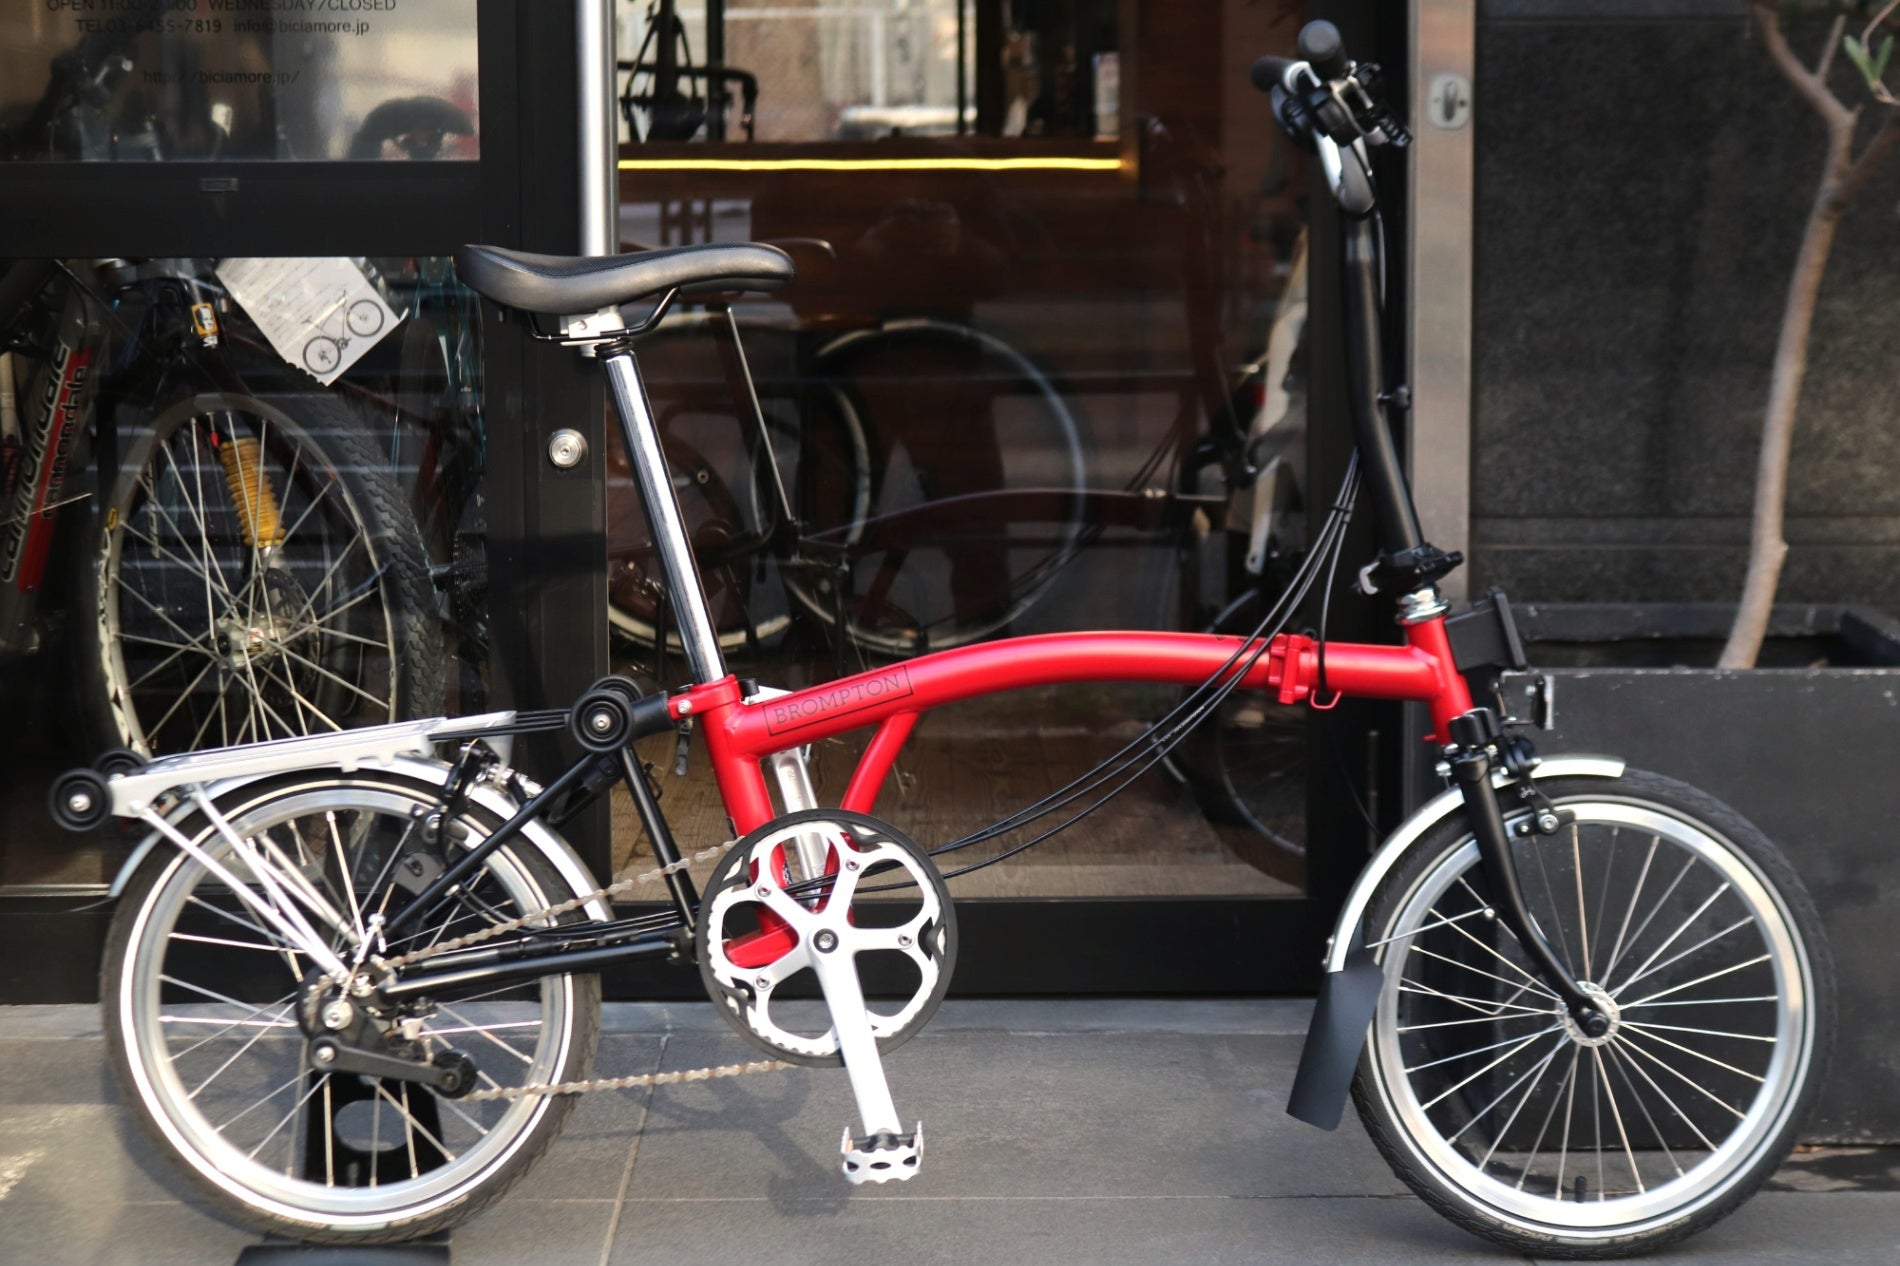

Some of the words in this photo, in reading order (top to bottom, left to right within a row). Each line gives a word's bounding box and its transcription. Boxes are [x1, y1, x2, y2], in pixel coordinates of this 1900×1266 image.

[46, 0, 96, 11] OPEN
[209, 0, 397, 11] WEDNESDAY/CLOSED
[233, 18, 370, 36] info@biciamore.jp
[143, 68, 300, 86] http://biciamore.jp/
[773, 674, 901, 725] BROMPTON
